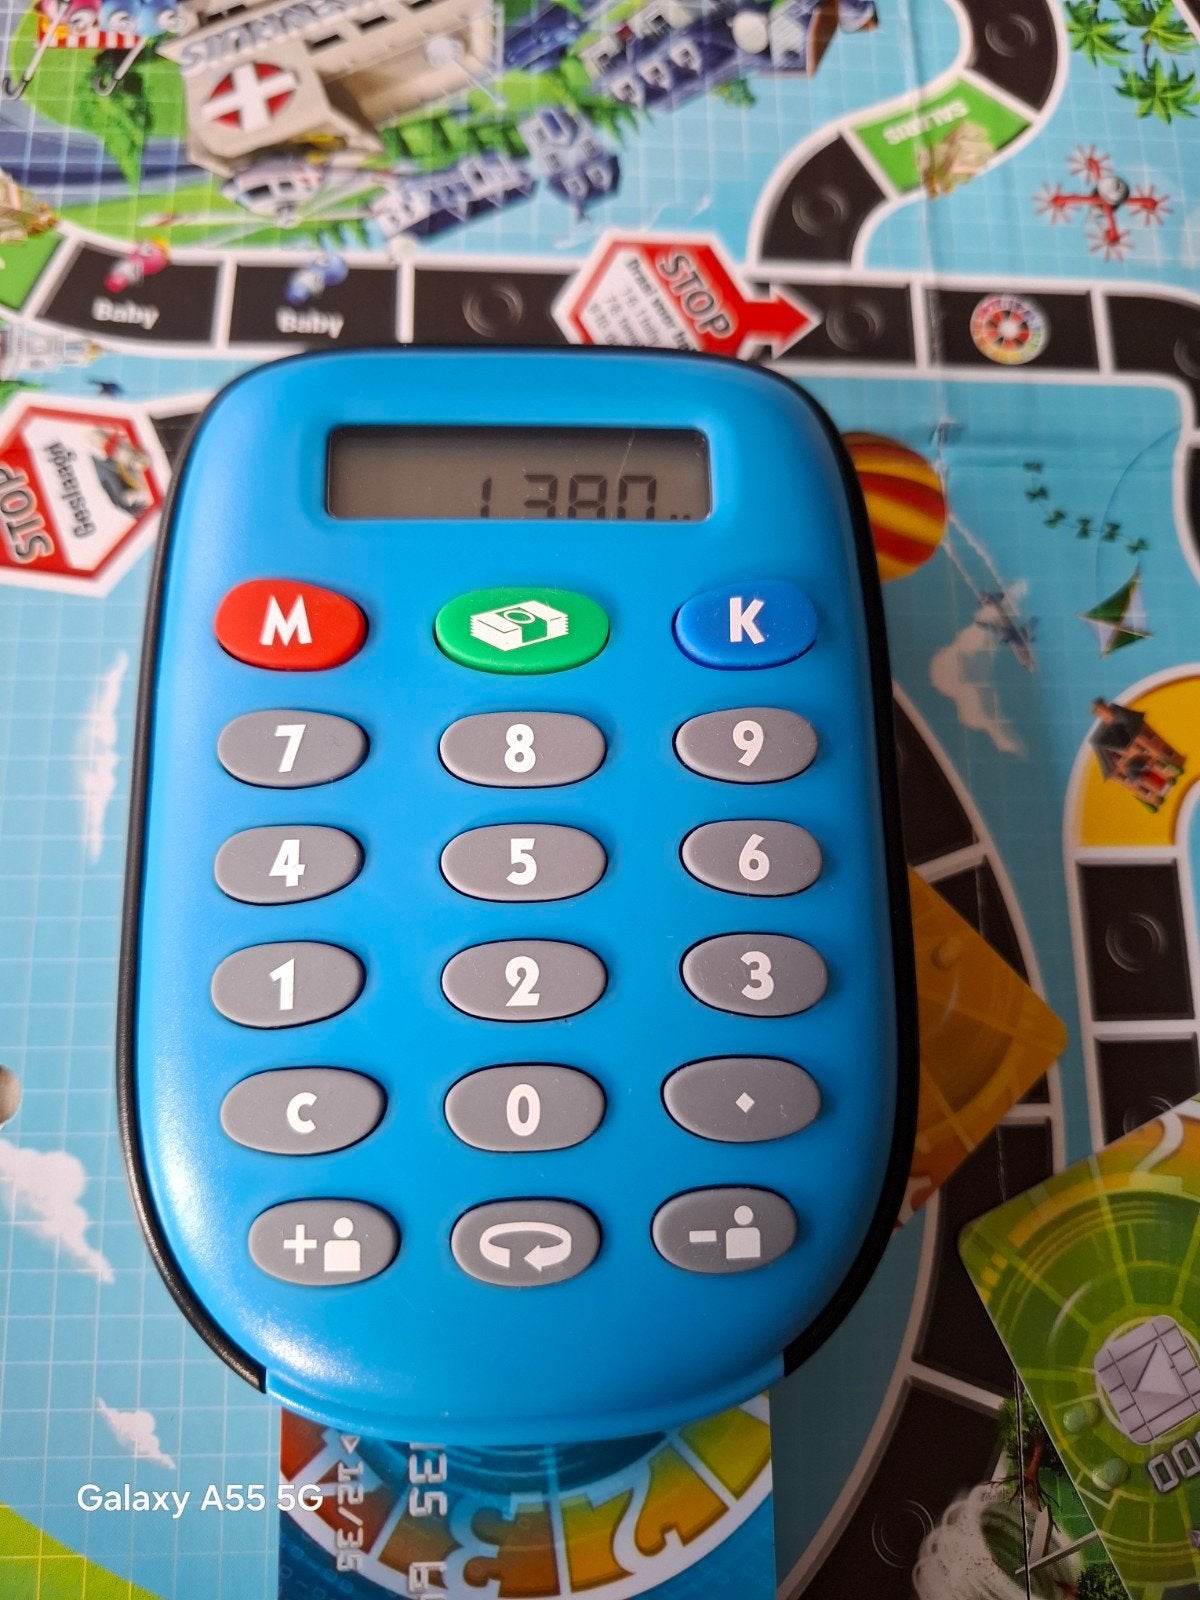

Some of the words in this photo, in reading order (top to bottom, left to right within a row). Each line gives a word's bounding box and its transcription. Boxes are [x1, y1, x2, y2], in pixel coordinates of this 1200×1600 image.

[92, 297, 159, 330] Baby
[660, 255, 730, 334] STOP
[276, 307, 344, 339] Baby
[261, 597, 311, 645] M
[729, 596, 765, 645] K
[273, 723, 307, 773] 7
[504, 723, 537, 773] 8
[732, 720, 764, 767] 9
[268, 838, 306, 888] 4
[505, 837, 538, 886] 5
[738, 833, 770, 882] 6
[268, 957, 295, 1011] 1
[504, 955, 541, 1007] 2
[740, 950, 774, 1001] 3
[506, 1083, 541, 1137] 0
[1148, 1433, 1200, 1493] 00
[336, 1461, 364, 1571] 12/35
